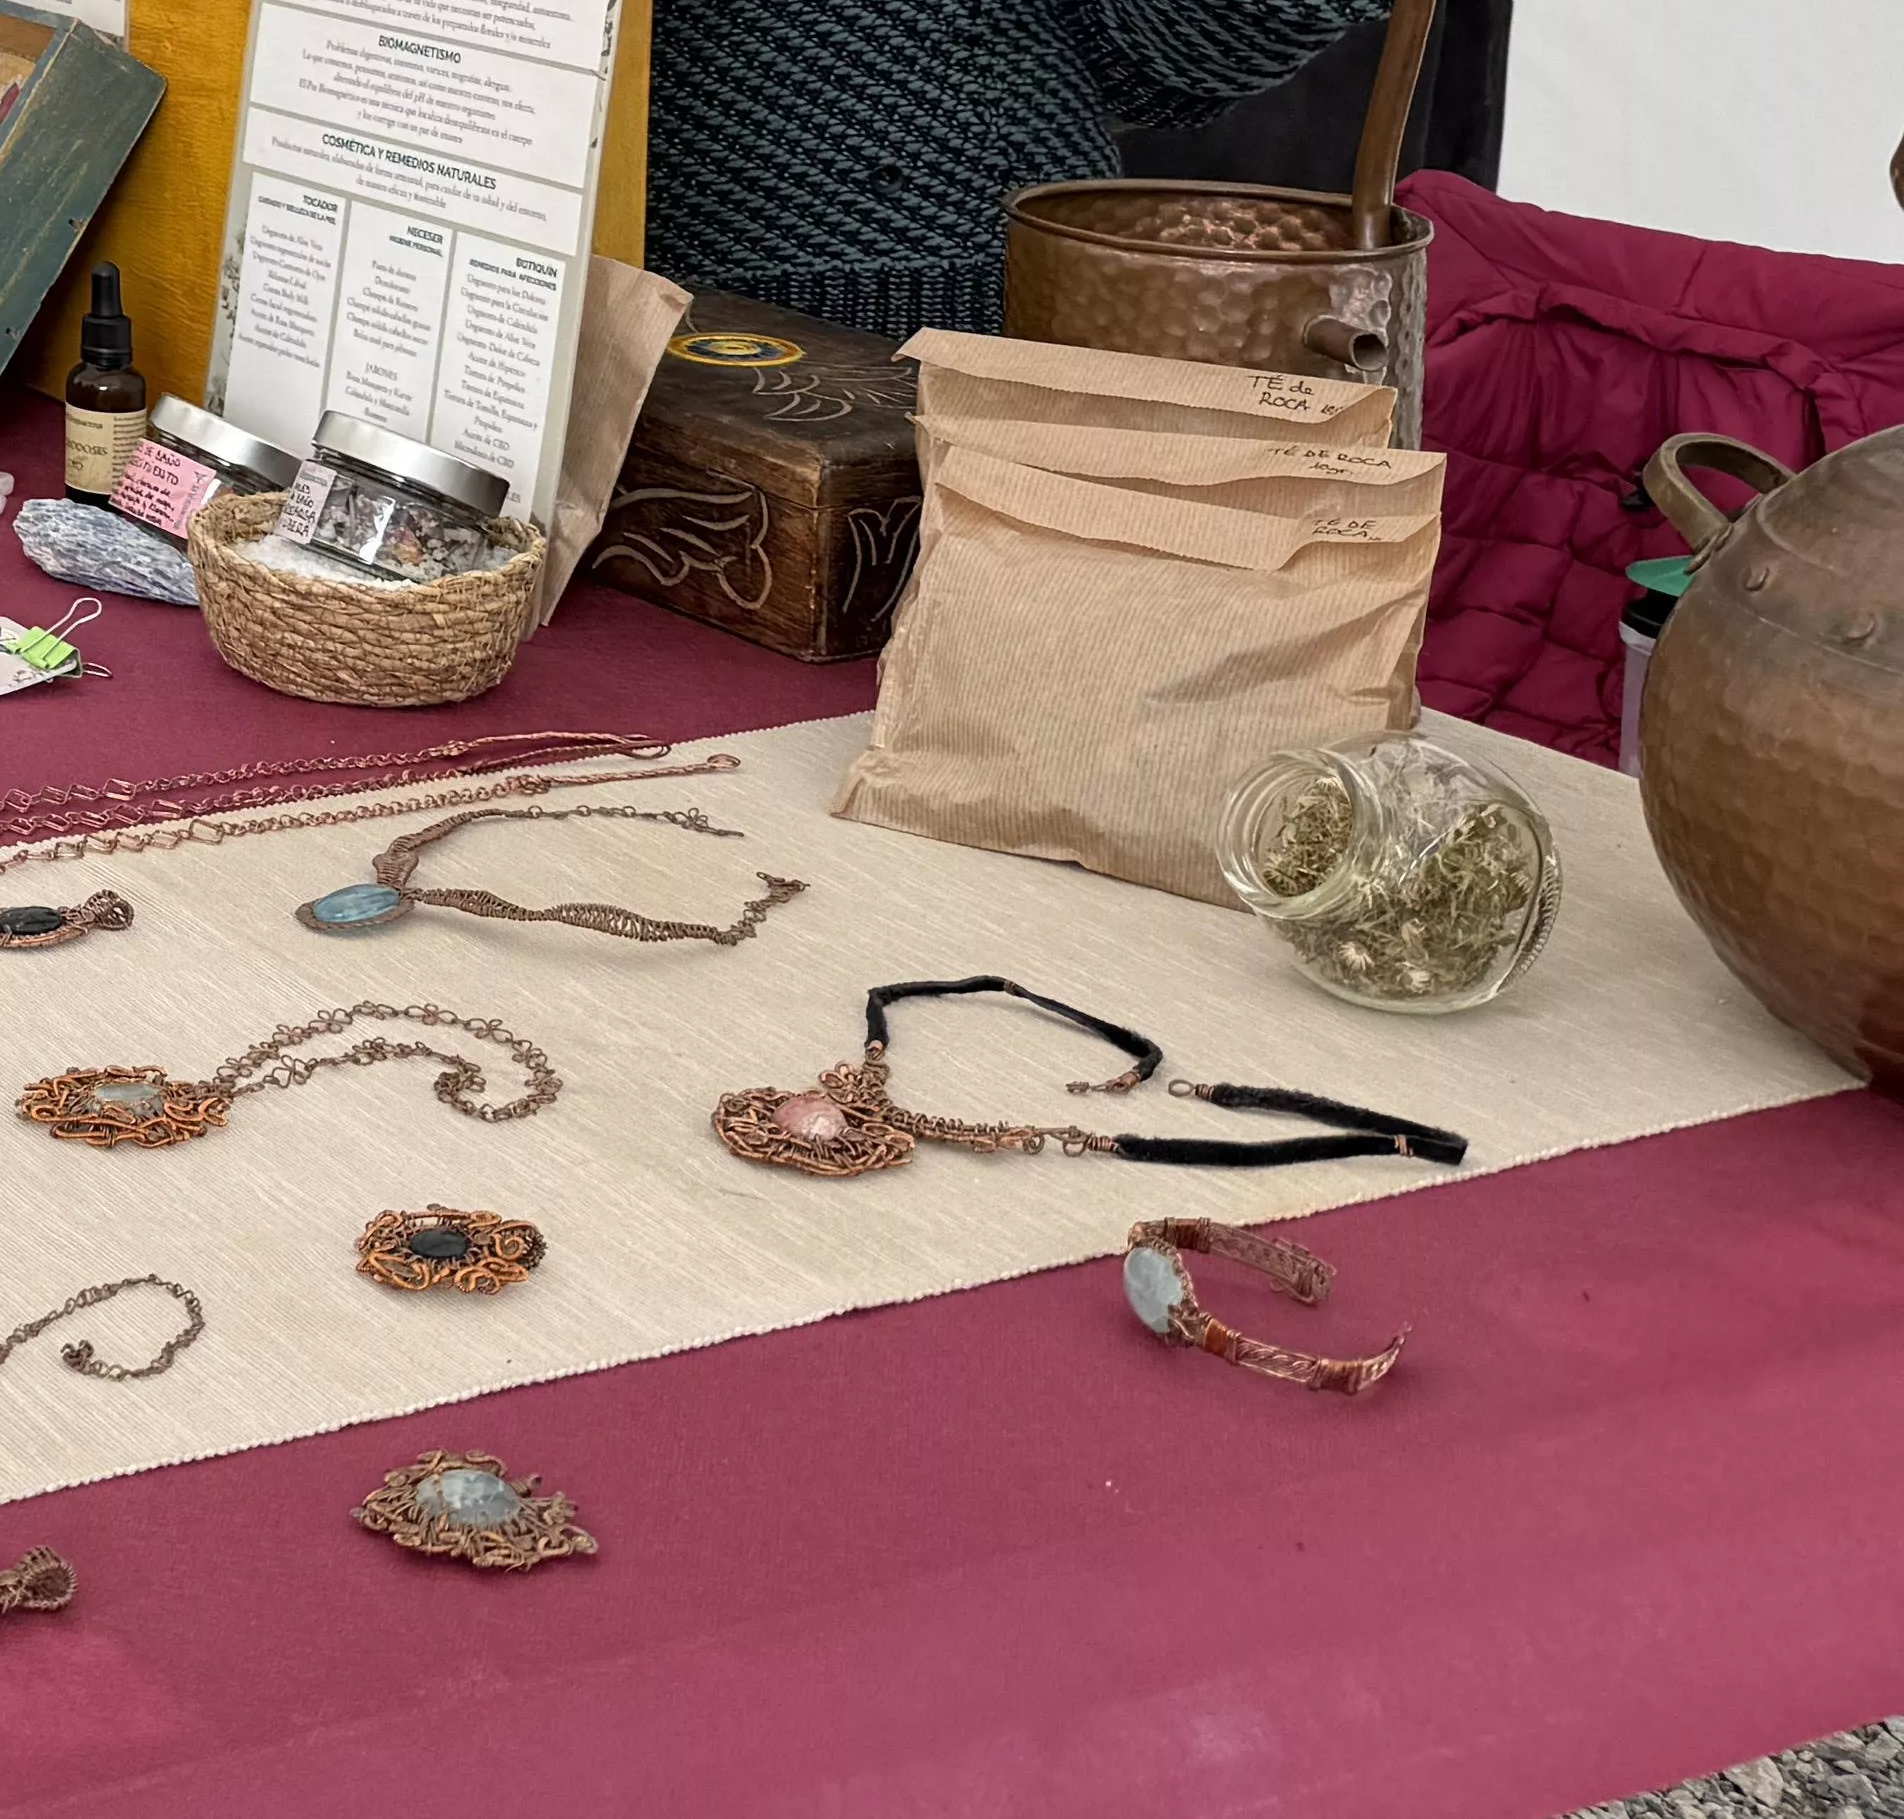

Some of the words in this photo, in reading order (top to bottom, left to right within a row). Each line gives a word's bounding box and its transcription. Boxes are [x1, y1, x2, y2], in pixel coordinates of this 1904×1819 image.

[378, 34, 462, 64] BIOMAGNETISMO
[376, 149, 385, 159] Y
[385, 151, 435, 174] REMEDIOS
[436, 163, 497, 190] NATURALES
[303, 195, 338, 213] TOCADOR
[407, 226, 443, 244] NECESER
[516, 257, 557, 278] BOTIQUÍN
[1247, 374, 1284, 391] TÉ
[1289, 380, 1315, 396] de
[1258, 391, 1312, 412] ROCA
[1337, 452, 1392, 470] ROCA
